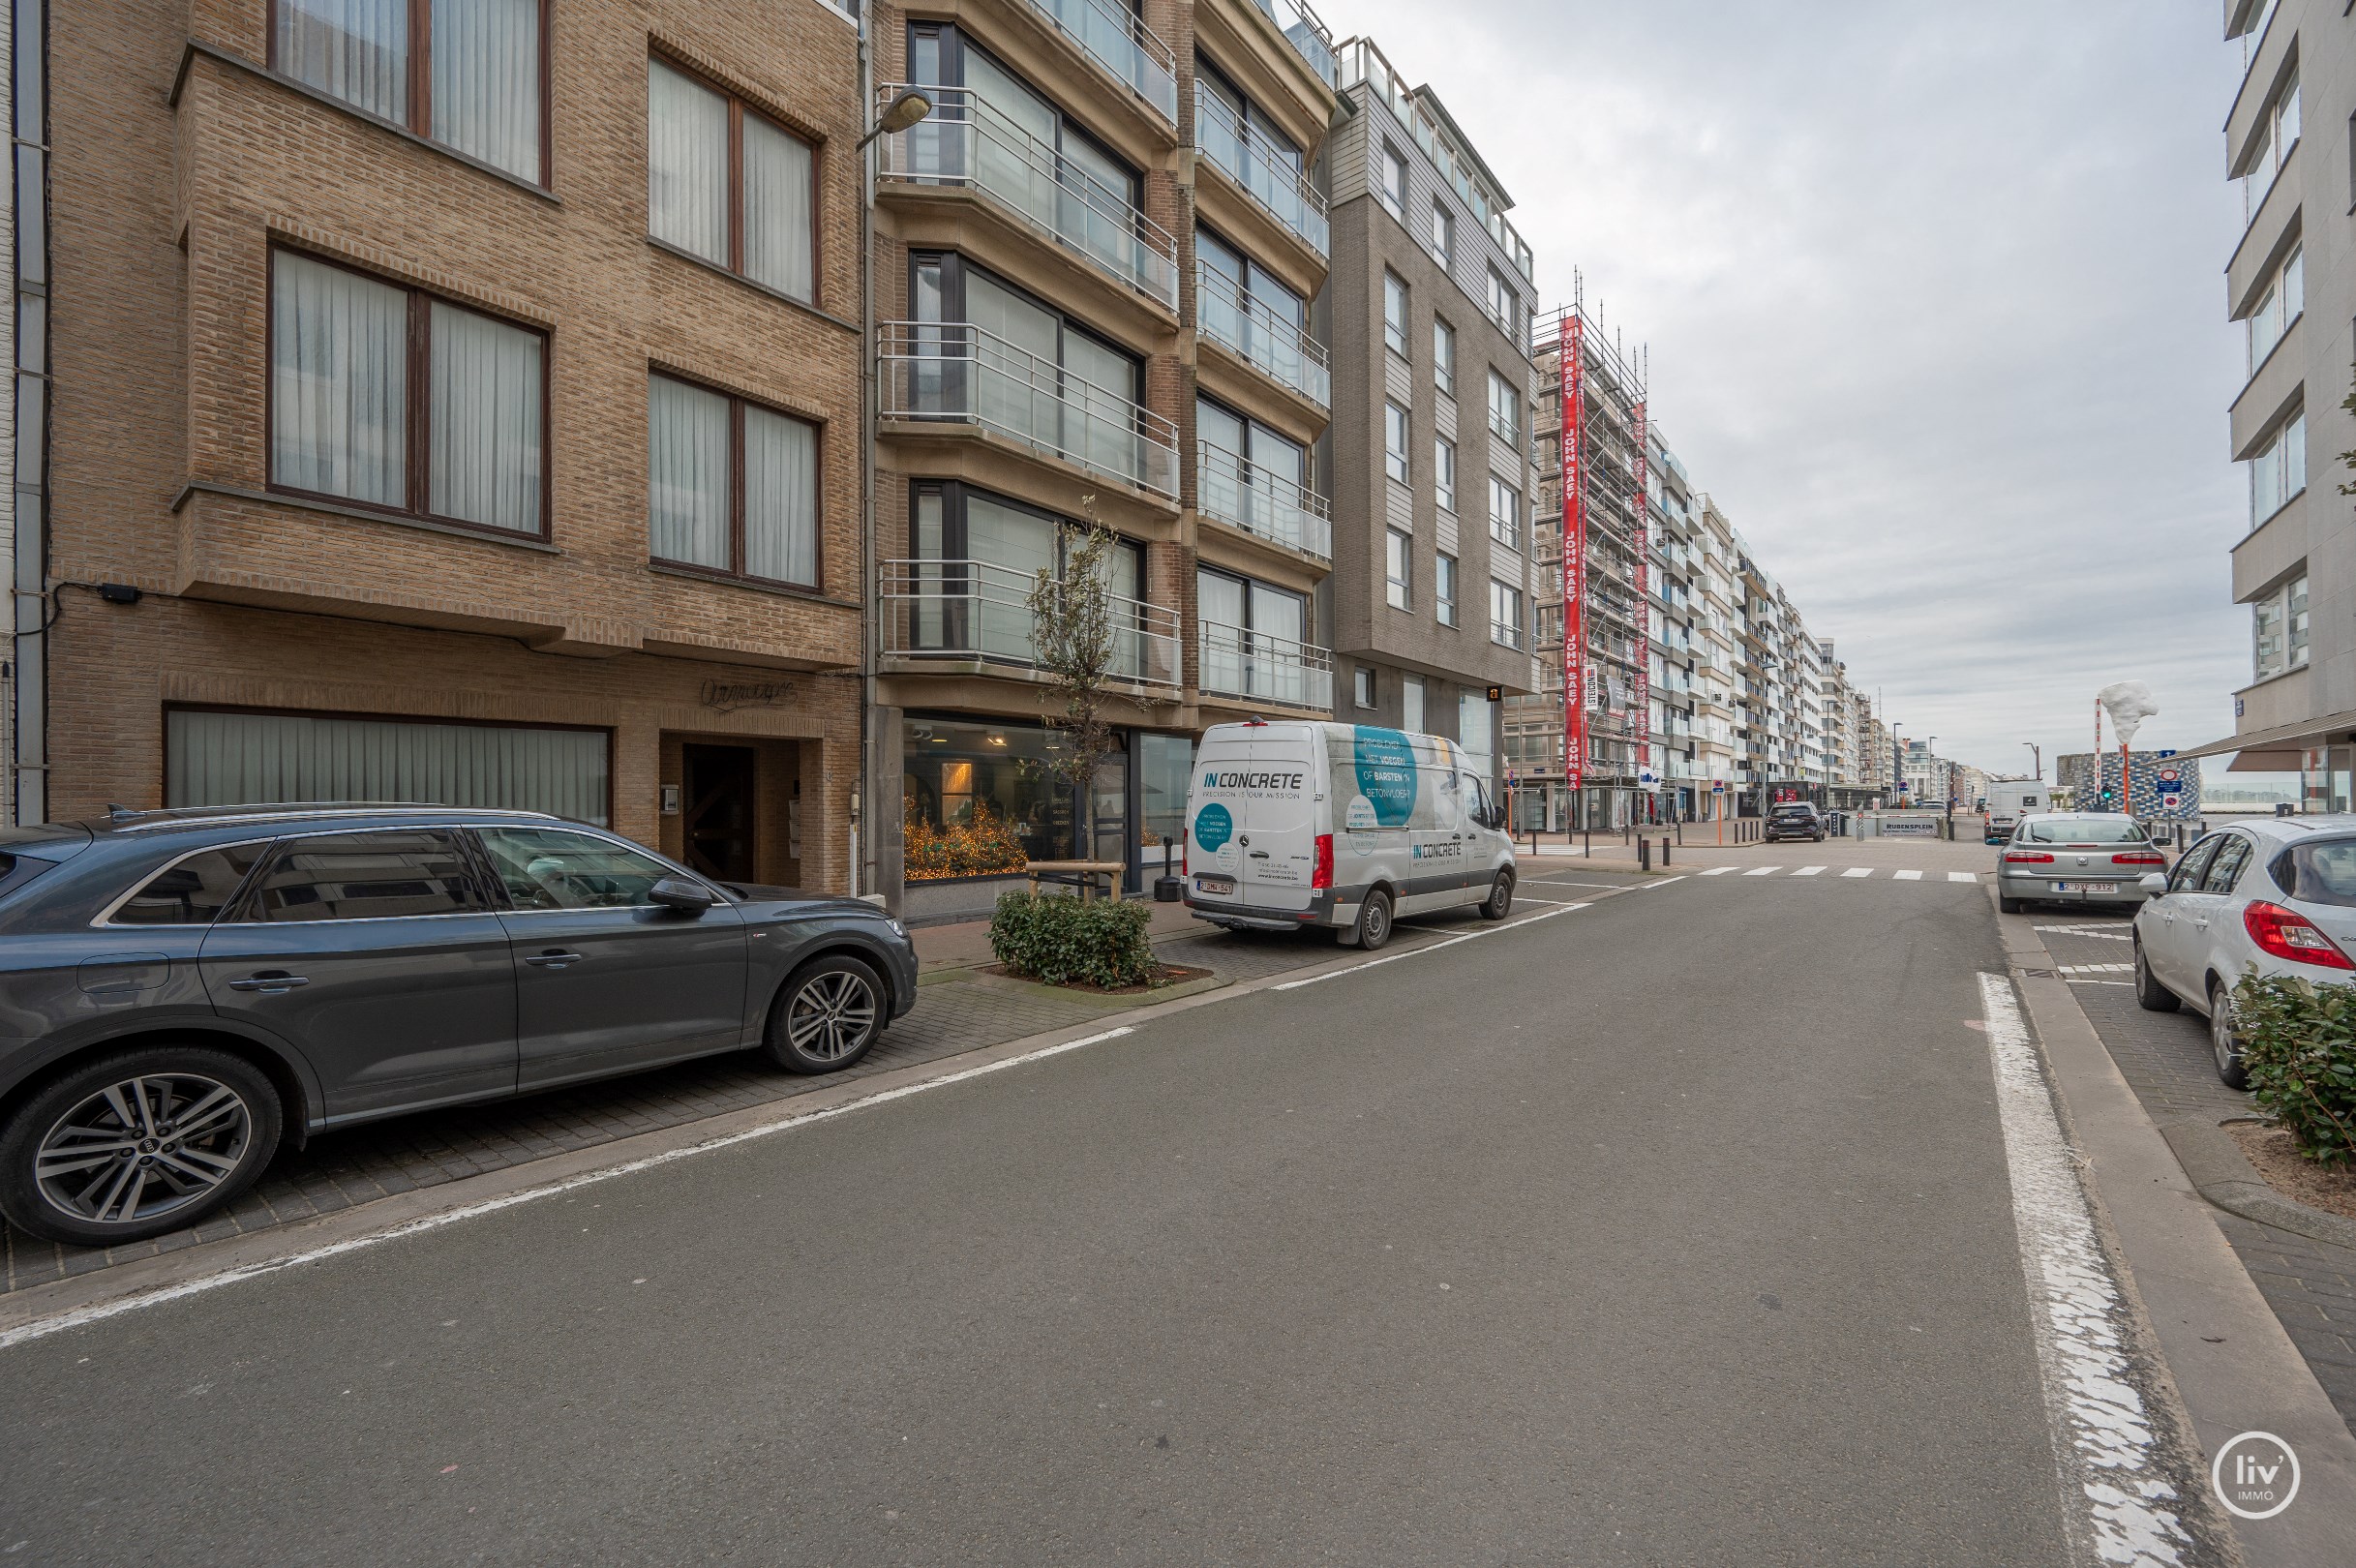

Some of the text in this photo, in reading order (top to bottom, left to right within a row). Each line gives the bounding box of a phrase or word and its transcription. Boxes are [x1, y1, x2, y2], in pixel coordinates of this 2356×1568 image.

[1563, 329, 1576, 399] JOHN SAEY
[1564, 428, 1576, 500] JOHN SAEY
[1565, 530, 1577, 603] JOHN SAEY
[1566, 634, 1578, 706] JOHN SAEY
[1587, 677, 1596, 704] STEICON
[1379, 755, 1405, 766] VOEGEN
[1568, 737, 1579, 769] JOHN
[1204, 772, 1304, 790] IN CONCRETE
[1363, 770, 1373, 780] OF
[1374, 771, 1403, 782] BARSTEN
[1413, 844, 1422, 859] IN
[1423, 842, 1462, 859] CONCRETE
